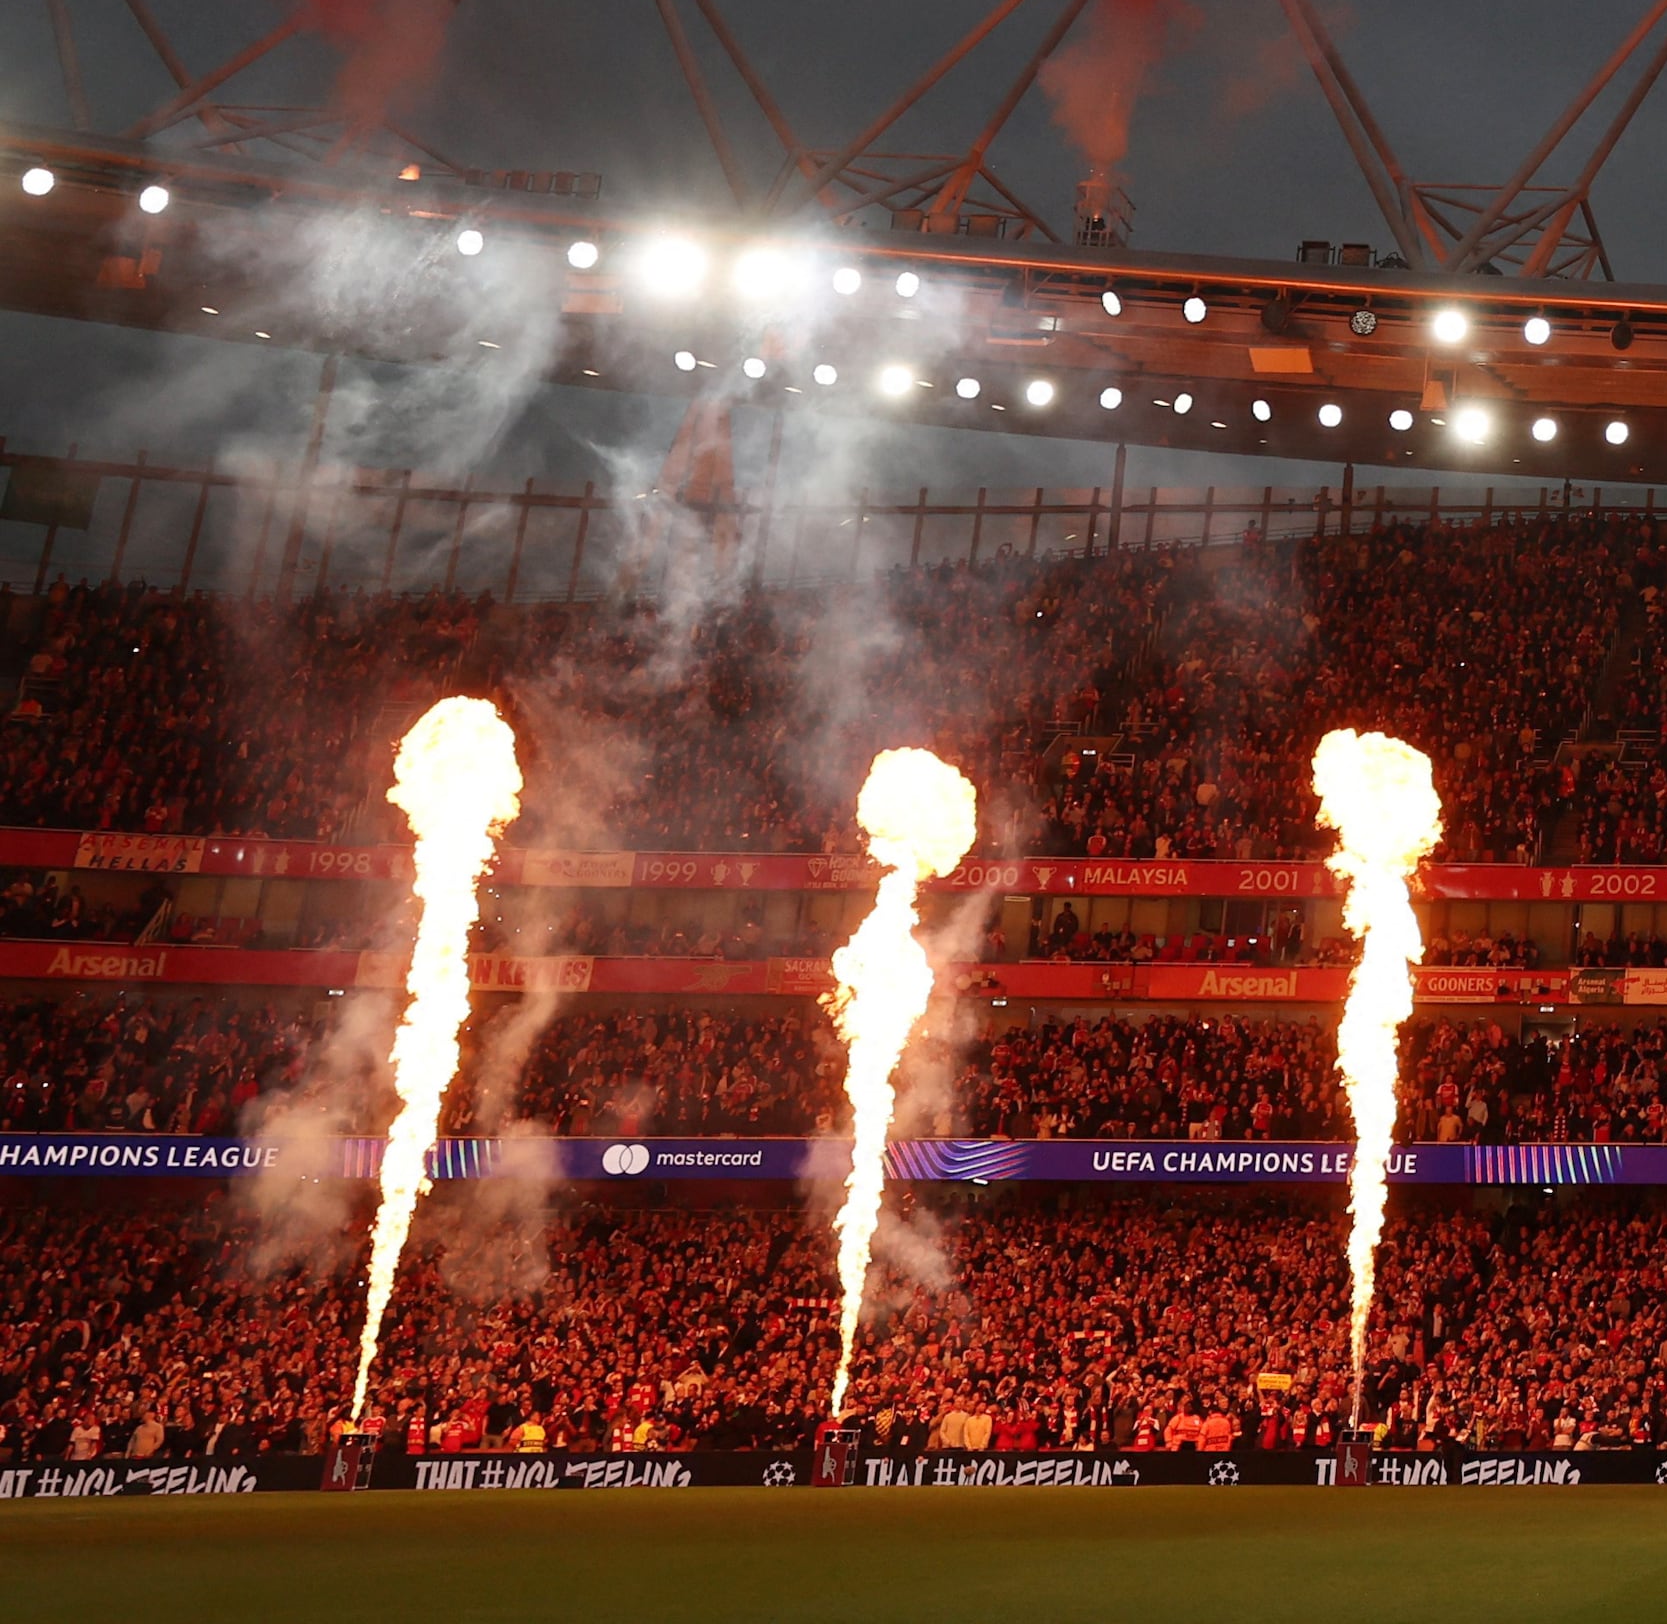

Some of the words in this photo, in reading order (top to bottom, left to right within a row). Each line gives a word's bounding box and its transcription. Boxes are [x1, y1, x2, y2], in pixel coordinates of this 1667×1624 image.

[80, 835, 202, 851] ARSENAL
[87, 855, 187, 871] HELLAS
[309, 851, 371, 873] 1998
[641, 860, 697, 883] 1999
[951, 866, 1018, 886] 2000
[1083, 866, 1188, 886] MALAYSIA
[1238, 870, 1299, 891] 2001
[1589, 874, 1656, 895] 2002
[47, 948, 166, 977] Arsenal
[1198, 970, 1296, 998] Arsenal
[1428, 977, 1494, 992] GOONERS
[1578, 977, 1606, 986] Arsenal
[1578, 986, 1605, 995] Algeria
[166, 1146, 279, 1168] LEAGUE
[656, 1150, 762, 1168] mastercard
[1092, 1151, 1156, 1172] UEFA
[1162, 1150, 1315, 1173] CHAMPIONS
[1321, 1152, 1418, 1174] LEUE
[415, 1460, 480, 1490] THAT
[865, 1458, 929, 1487] THAT
